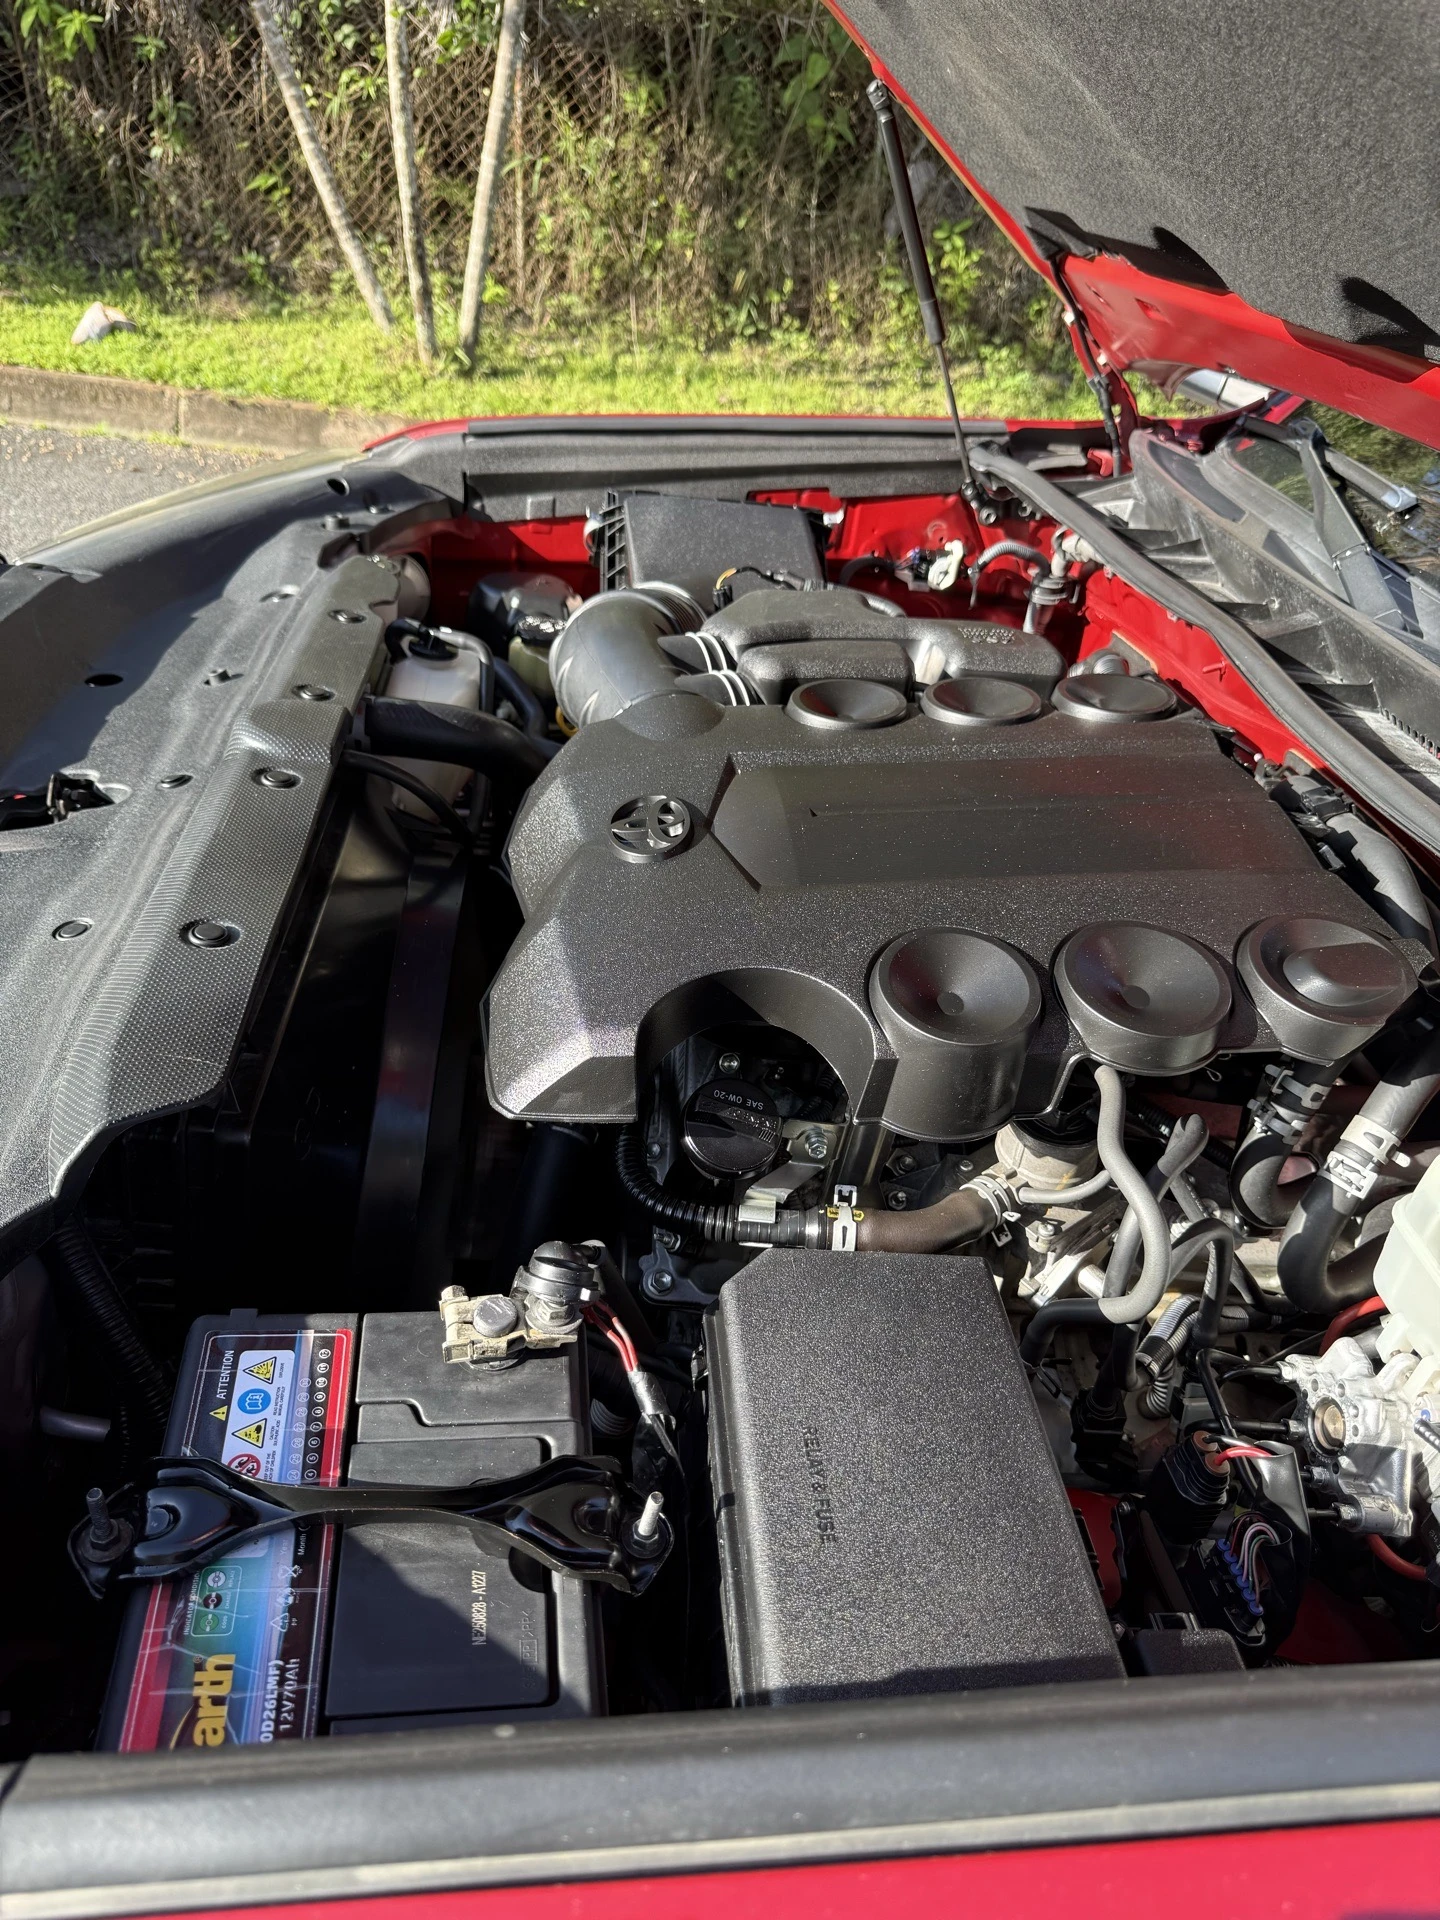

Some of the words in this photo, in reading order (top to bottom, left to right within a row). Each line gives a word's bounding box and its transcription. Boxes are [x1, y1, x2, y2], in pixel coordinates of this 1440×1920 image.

[713, 1089, 743, 1104] 0W-20
[746, 1098, 764, 1110] SAE
[216, 1350, 235, 1400] ATTENTION
[802, 1426, 825, 1478] RELAY
[811, 1481, 828, 1494] &
[815, 1499, 838, 1544] FUSE
[298, 1533, 307, 1556] Month
[472, 1570, 487, 1595] A1227
[183, 1603, 195, 1636] INDICATOR
[190, 1570, 200, 1602] CONDITIO
[472, 1602, 487, 1646] NE250828
